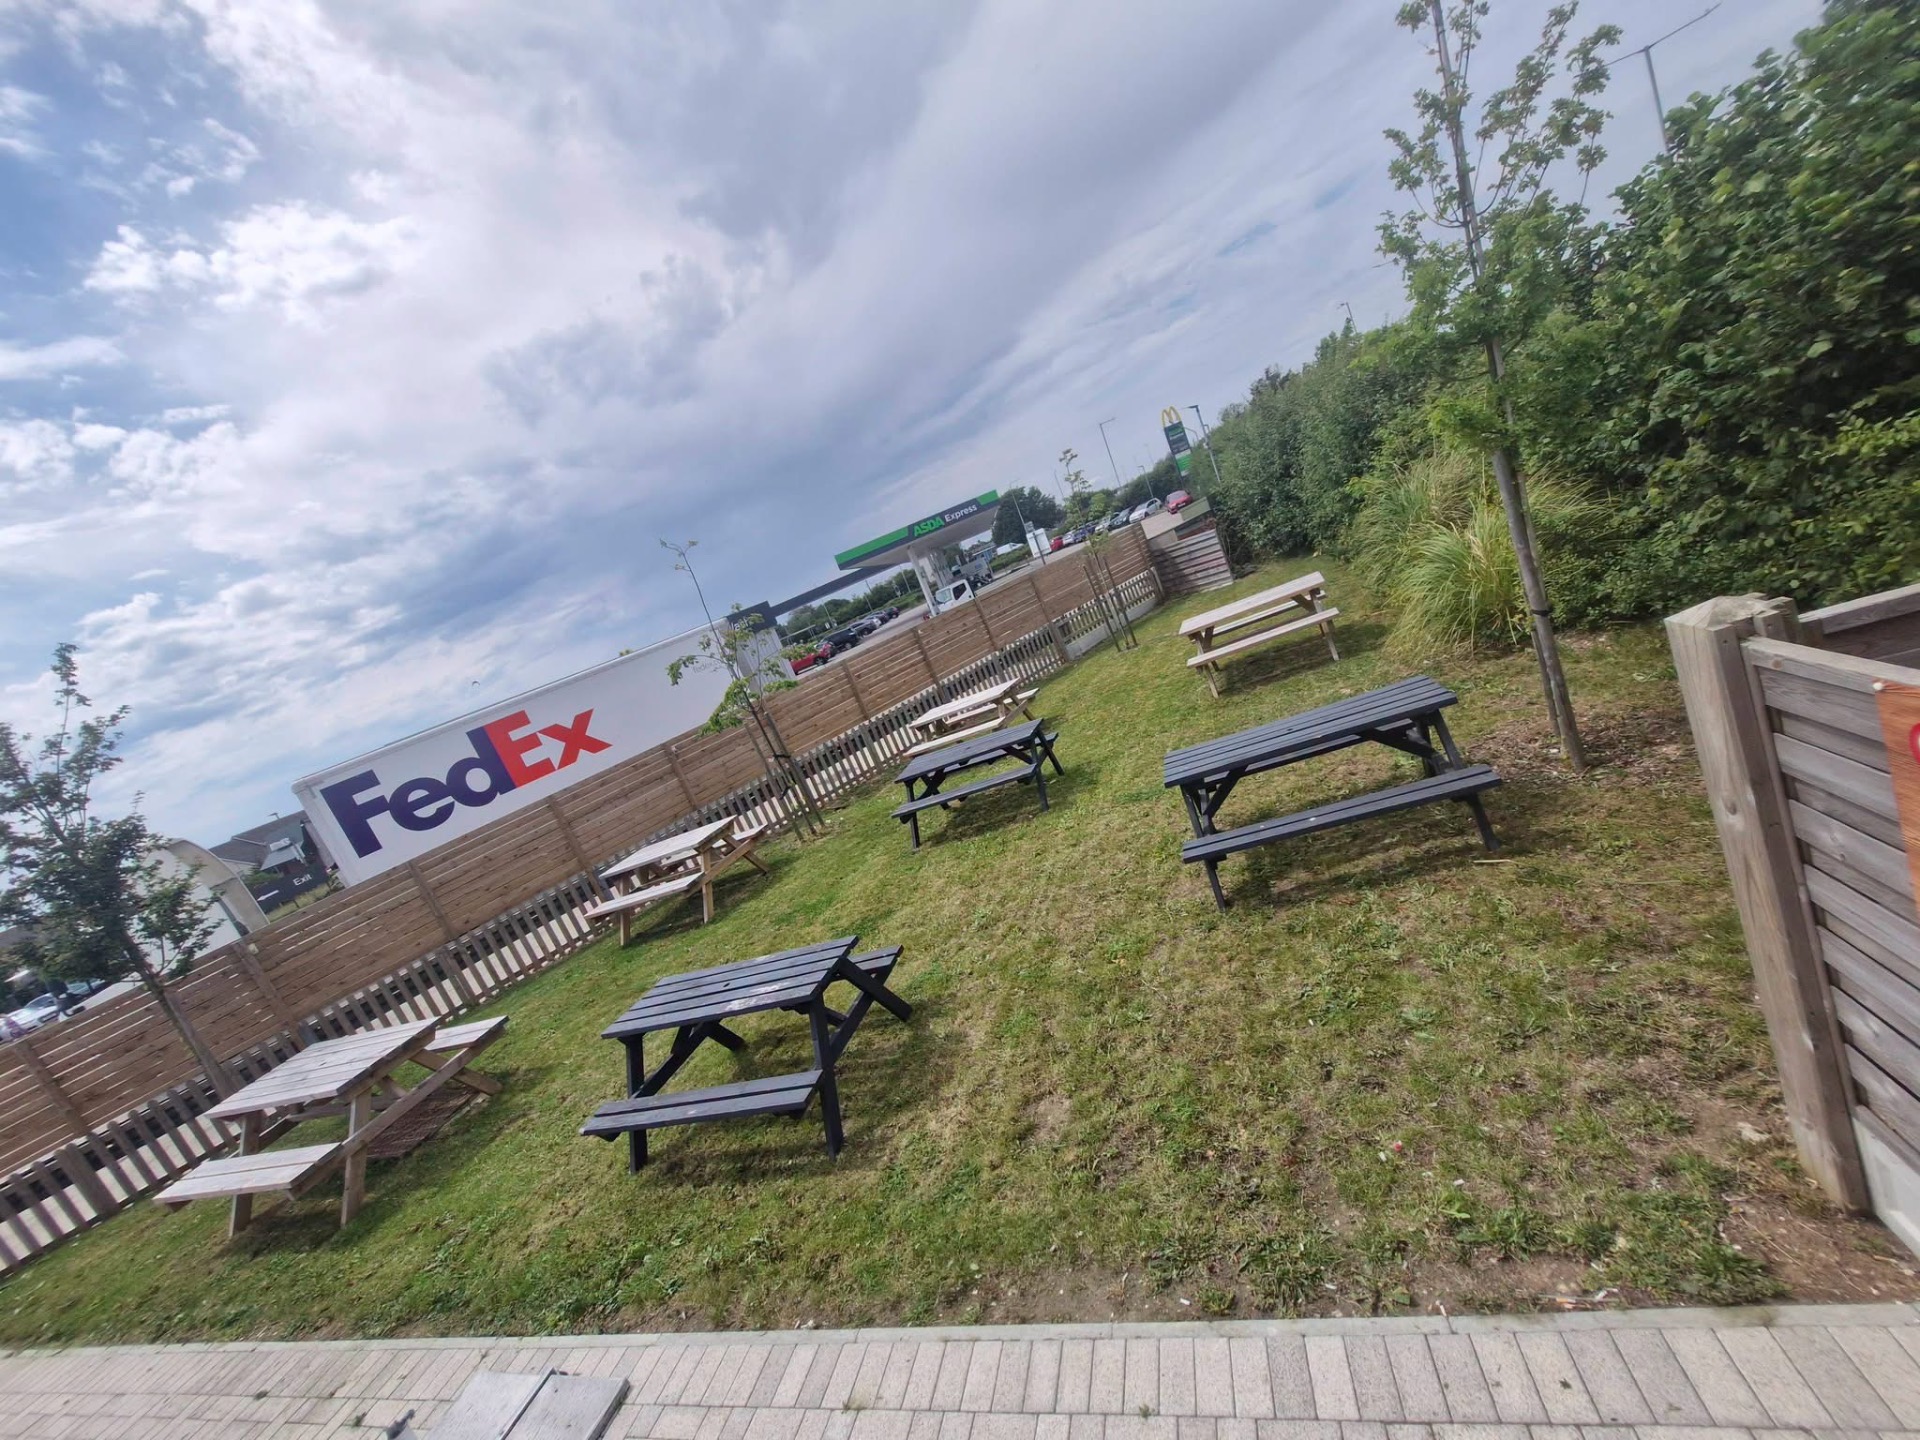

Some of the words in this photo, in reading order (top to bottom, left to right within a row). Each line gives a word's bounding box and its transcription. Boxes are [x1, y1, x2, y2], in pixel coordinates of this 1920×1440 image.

[913, 516, 945, 537] ASDA
[944, 504, 978, 522] Express
[319, 708, 613, 859] FedEx
[293, 873, 312, 886] Exit
